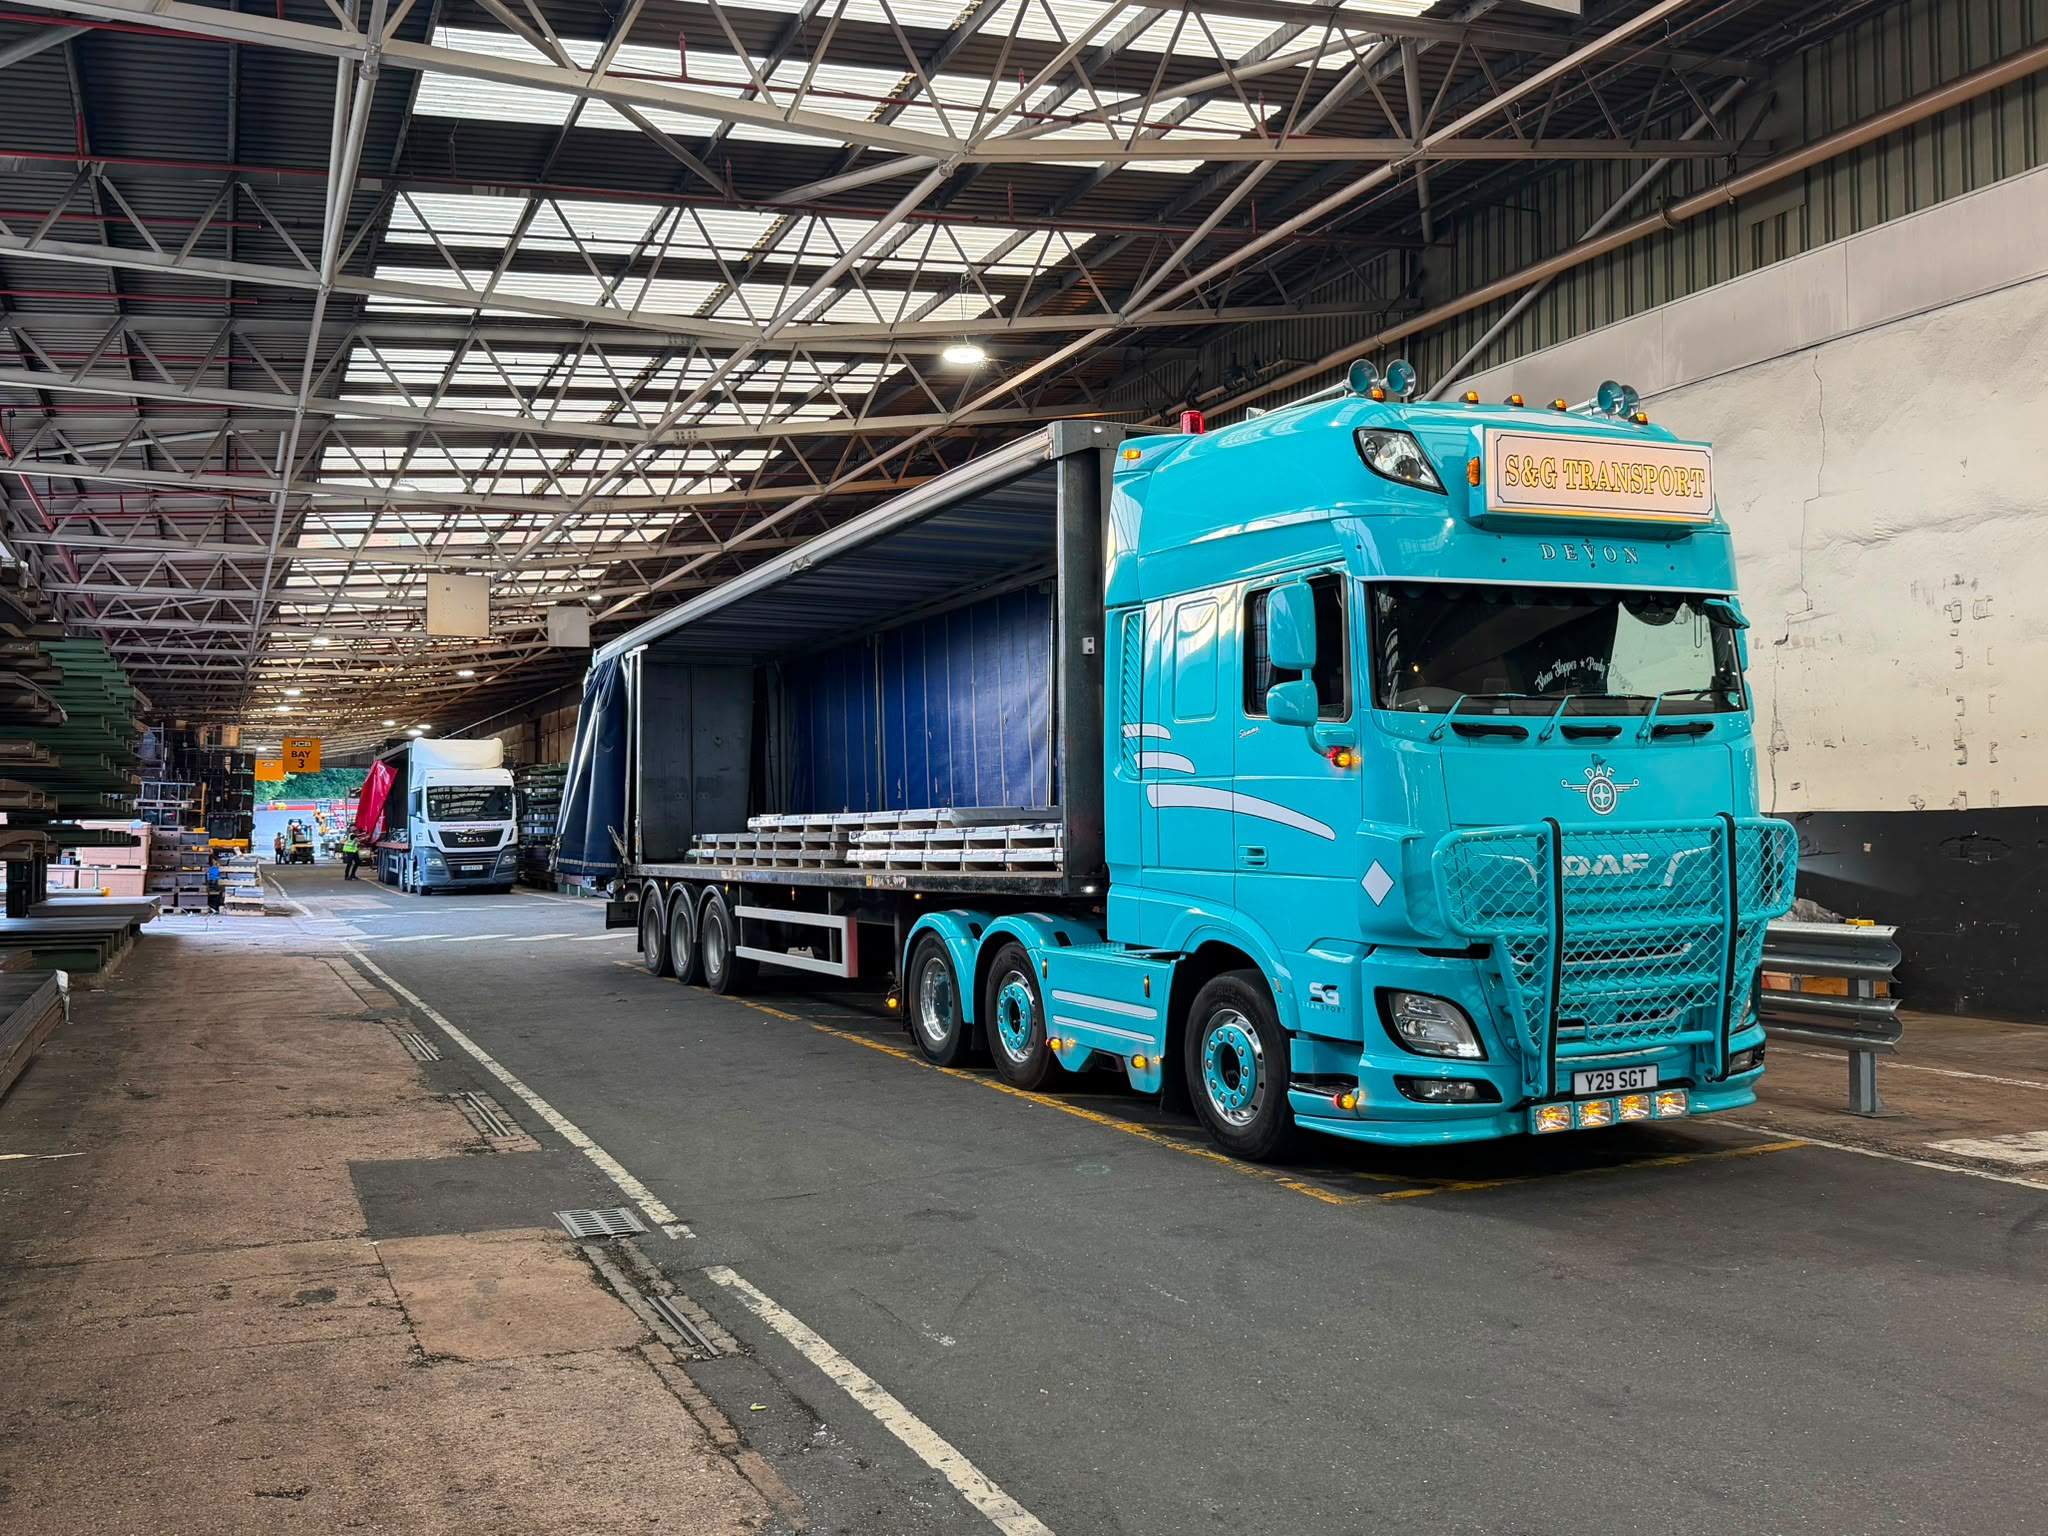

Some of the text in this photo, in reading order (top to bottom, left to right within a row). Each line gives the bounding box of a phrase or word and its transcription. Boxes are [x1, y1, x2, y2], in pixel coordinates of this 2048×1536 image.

[1505, 454, 1705, 498] S&G TRANSPORT
[1539, 543, 1638, 564] DEVON
[297, 759, 305, 769] 3
[1583, 764, 1615, 780] DAF
[1562, 853, 1649, 877] DAF
[1309, 982, 1340, 1006] SG
[1585, 1068, 1647, 1092] Y29 SGT
